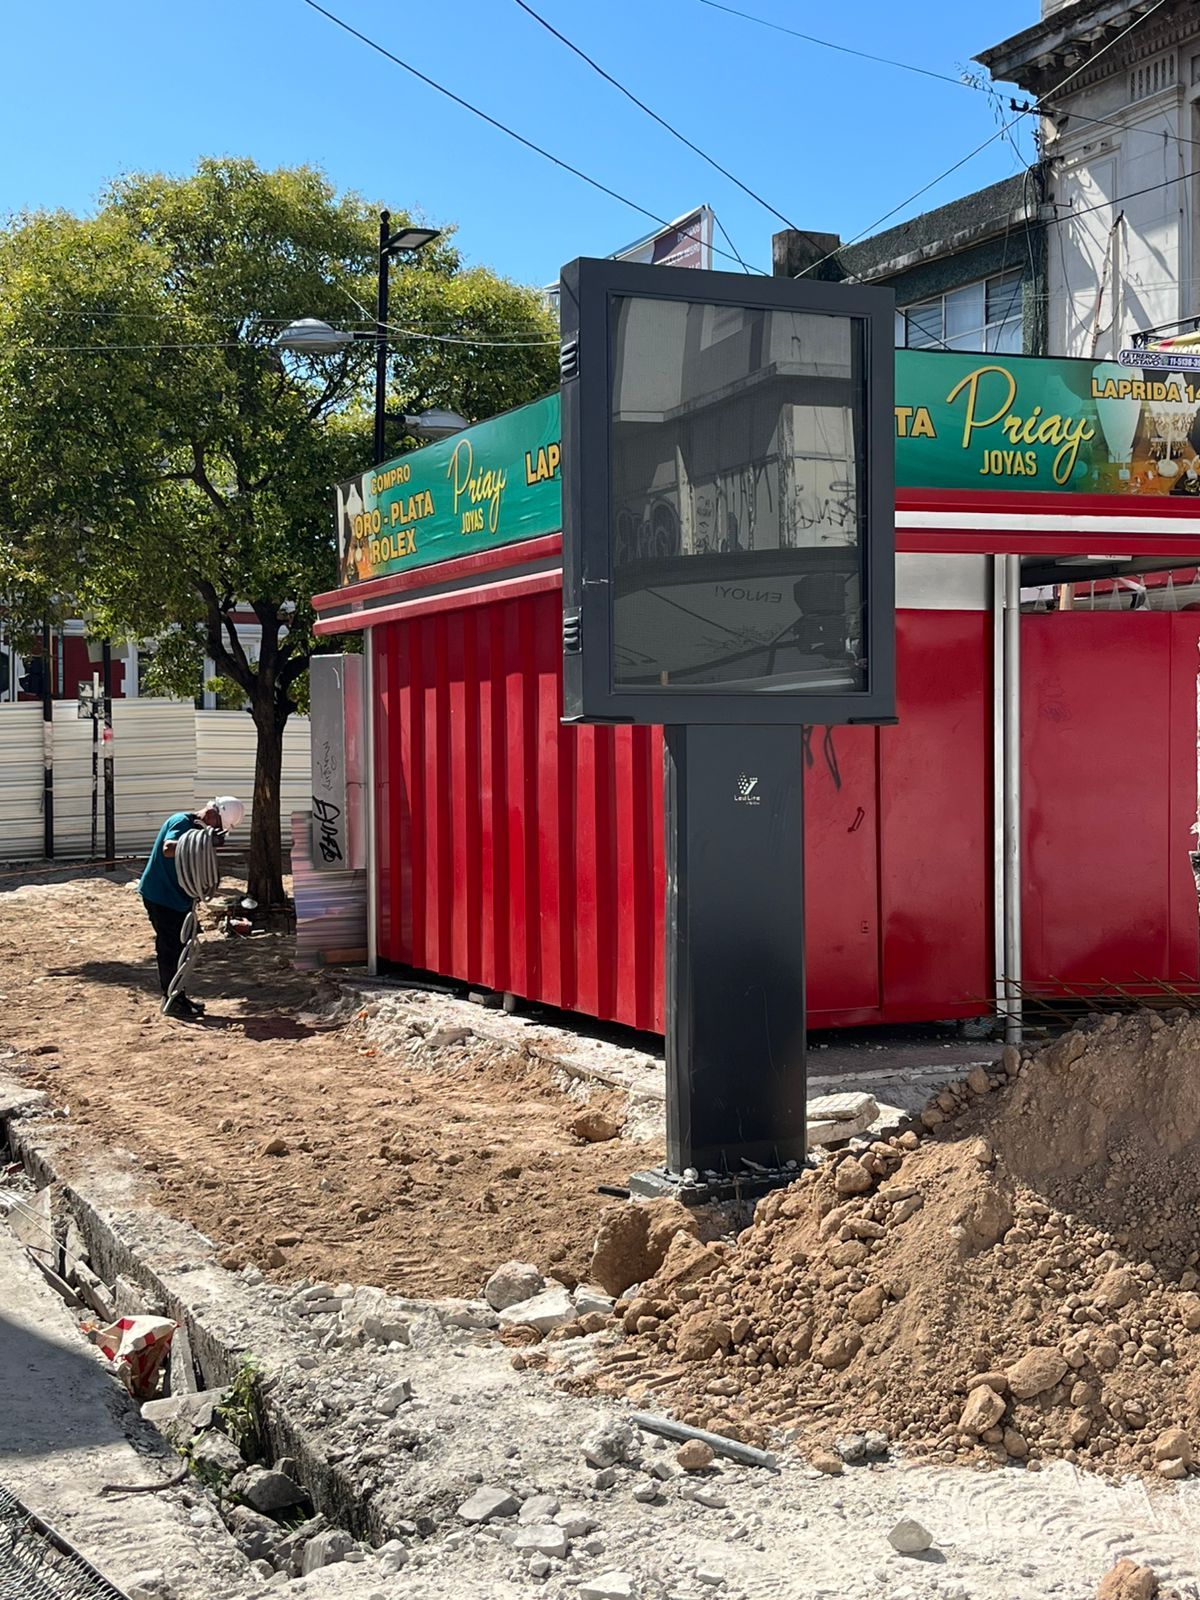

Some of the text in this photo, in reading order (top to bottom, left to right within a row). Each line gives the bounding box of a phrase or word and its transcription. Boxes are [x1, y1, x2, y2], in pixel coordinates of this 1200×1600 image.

[1122, 352, 1161, 361] LETREROS
[1091, 378, 1182, 402] LAPRIDA
[946, 365, 1096, 485] Priay
[525, 440, 561, 487] LAP
[980, 449, 1037, 476] JOYAS
[370, 463, 410, 494] COMPRO
[354, 509, 382, 540] ORO
[390, 489, 435, 528] PLATA
[461, 508, 485, 535] JOYAS
[370, 528, 416, 565] ROLEX
